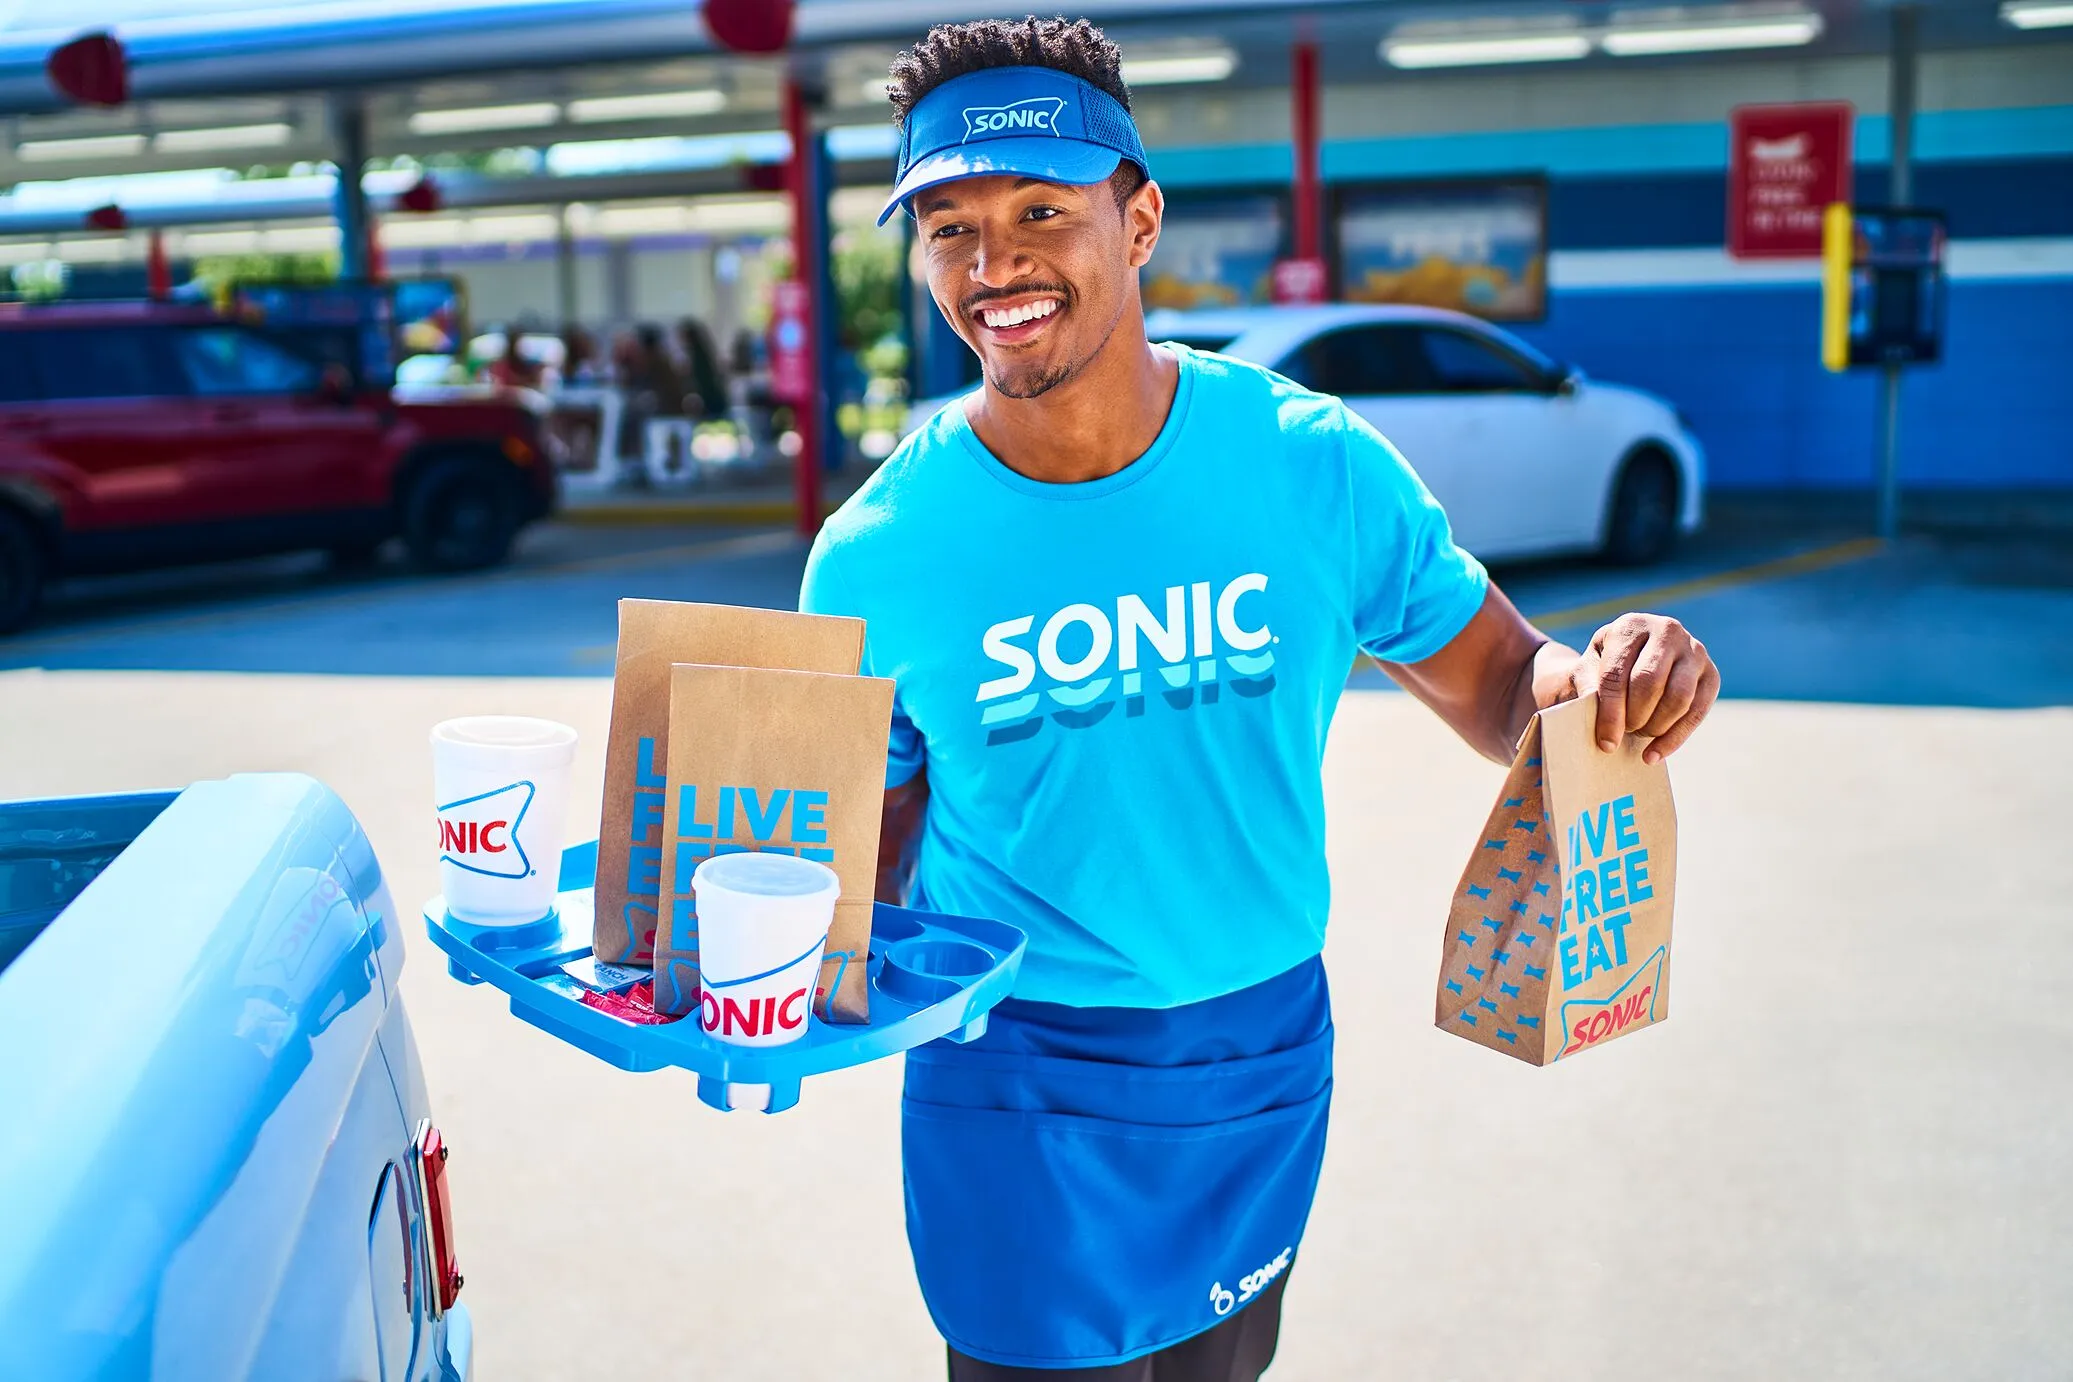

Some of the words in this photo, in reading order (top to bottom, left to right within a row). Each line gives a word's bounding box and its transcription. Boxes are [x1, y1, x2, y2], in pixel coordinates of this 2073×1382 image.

[972, 110, 1049, 134] SONIC
[975, 573, 1272, 702] SONIC
[438, 817, 507, 853] NIC
[677, 784, 828, 843] LIVE
[1560, 912, 1632, 991] EAT
[1564, 986, 1651, 1055] SONIC
[1238, 1246, 1292, 1302] SONIC
